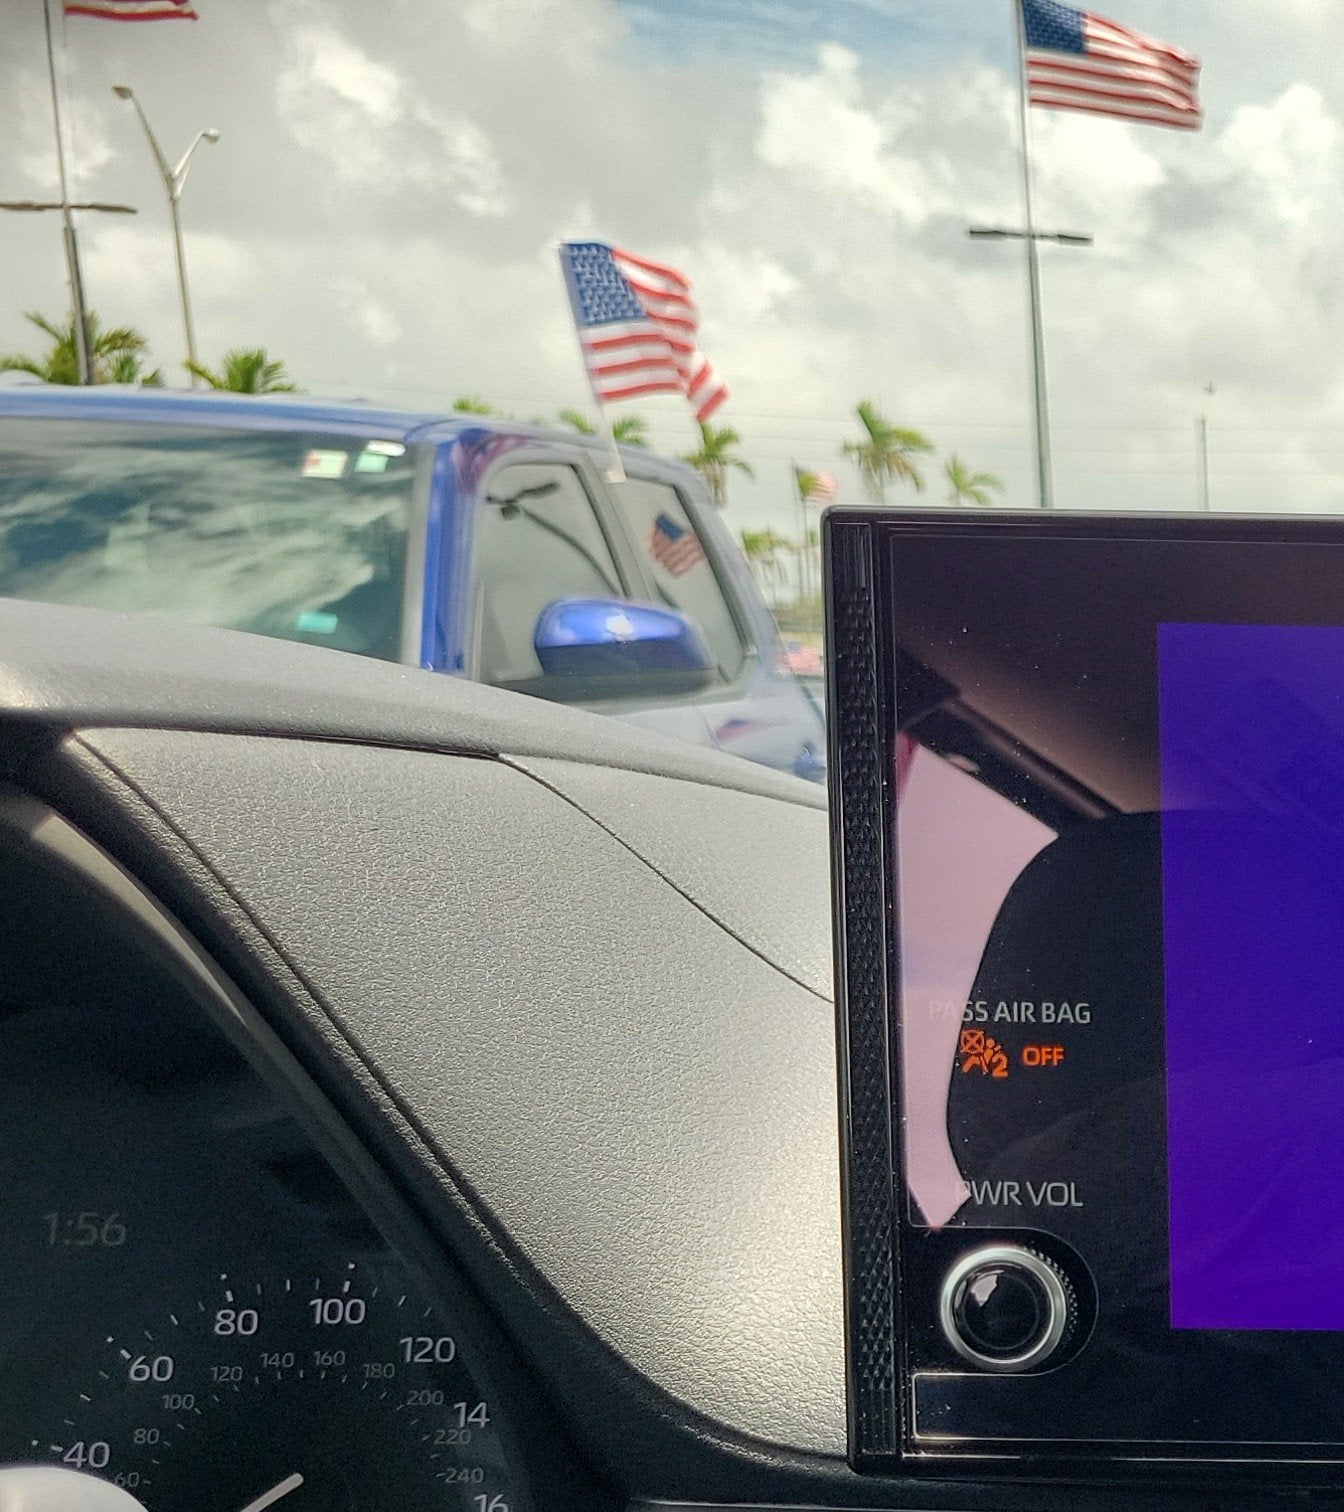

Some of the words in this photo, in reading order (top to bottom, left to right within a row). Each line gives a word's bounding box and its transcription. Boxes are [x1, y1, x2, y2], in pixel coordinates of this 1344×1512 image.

[994, 1002, 1035, 1022] AIR
[1042, 1003, 1090, 1024] BAG
[1022, 1046, 1064, 1066] OFF
[1026, 1182, 1083, 1206] VOL
[43, 1213, 127, 1248] 1:56
[309, 1299, 366, 1326] 100
[214, 1310, 258, 1336] 80
[313, 1350, 346, 1367] 160
[400, 1337, 455, 1363] 120
[129, 1356, 173, 1382] 60
[260, 1352, 294, 1369] 140
[210, 1366, 242, 1383] 120
[363, 1363, 396, 1380] 180
[163, 1393, 195, 1411] 100
[407, 1389, 444, 1406] 200
[453, 1403, 490, 1427] 14
[133, 1427, 159, 1445] 80
[433, 1428, 471, 1445] 220
[63, 1443, 110, 1468] 40
[443, 1467, 484, 1484] 240
